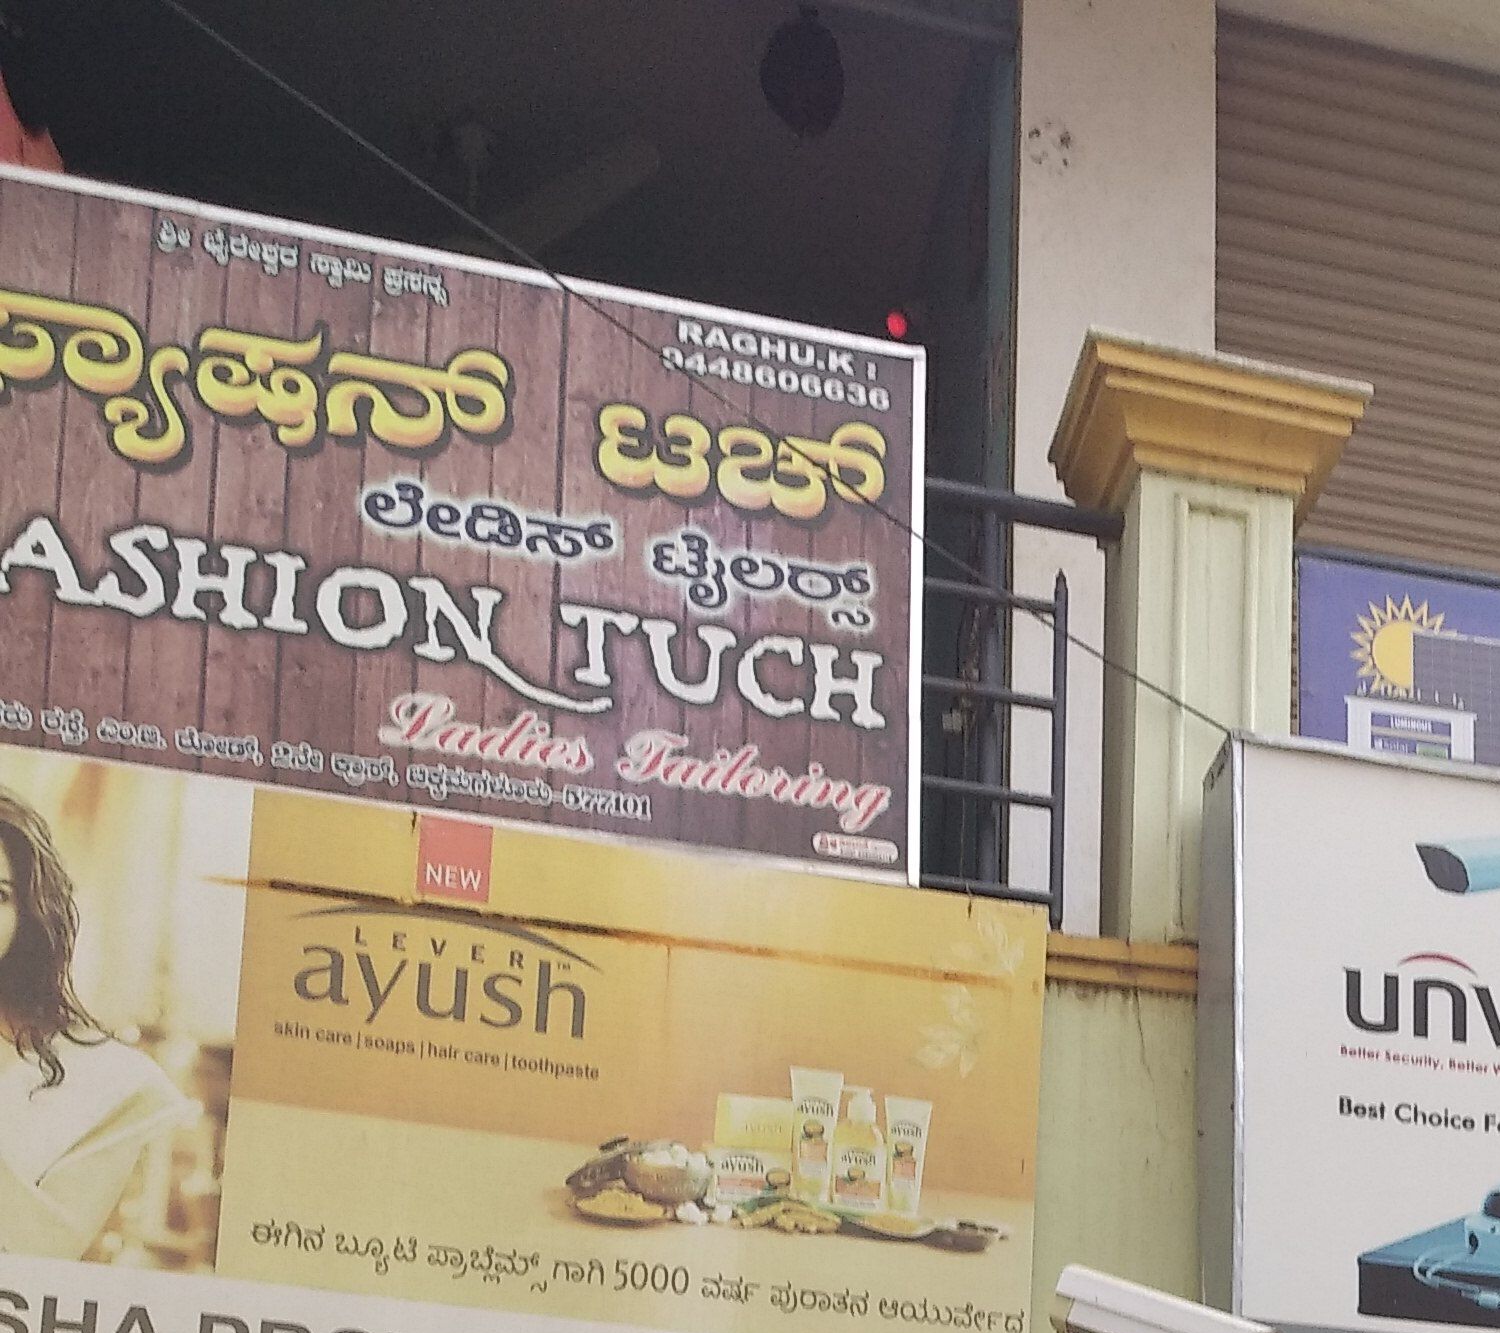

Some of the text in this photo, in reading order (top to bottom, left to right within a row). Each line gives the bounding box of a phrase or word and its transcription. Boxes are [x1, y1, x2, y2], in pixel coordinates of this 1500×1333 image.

[677, 319, 855, 376] RAGHU.K
[598, 403, 887, 519] ಟಚ್
[365, 482, 615, 559] ಲೇಡಿಸ್
[561, 603, 887, 730] TUCH
[378, 692, 892, 832] Ladies Tailoring
[424, 862, 482, 892] NEW
[355, 925, 525, 970] LEVER
[294, 944, 586, 1039] ayush
[274, 1021, 599, 1080] skin care soaps hair care toothpaste
[1339, 1096, 1386, 1121] Best
[1394, 1103, 1475, 1132] Choice
[251, 1219, 326, 1252] ಈಗಿನ
[613, 1259, 689, 1295] 5000
